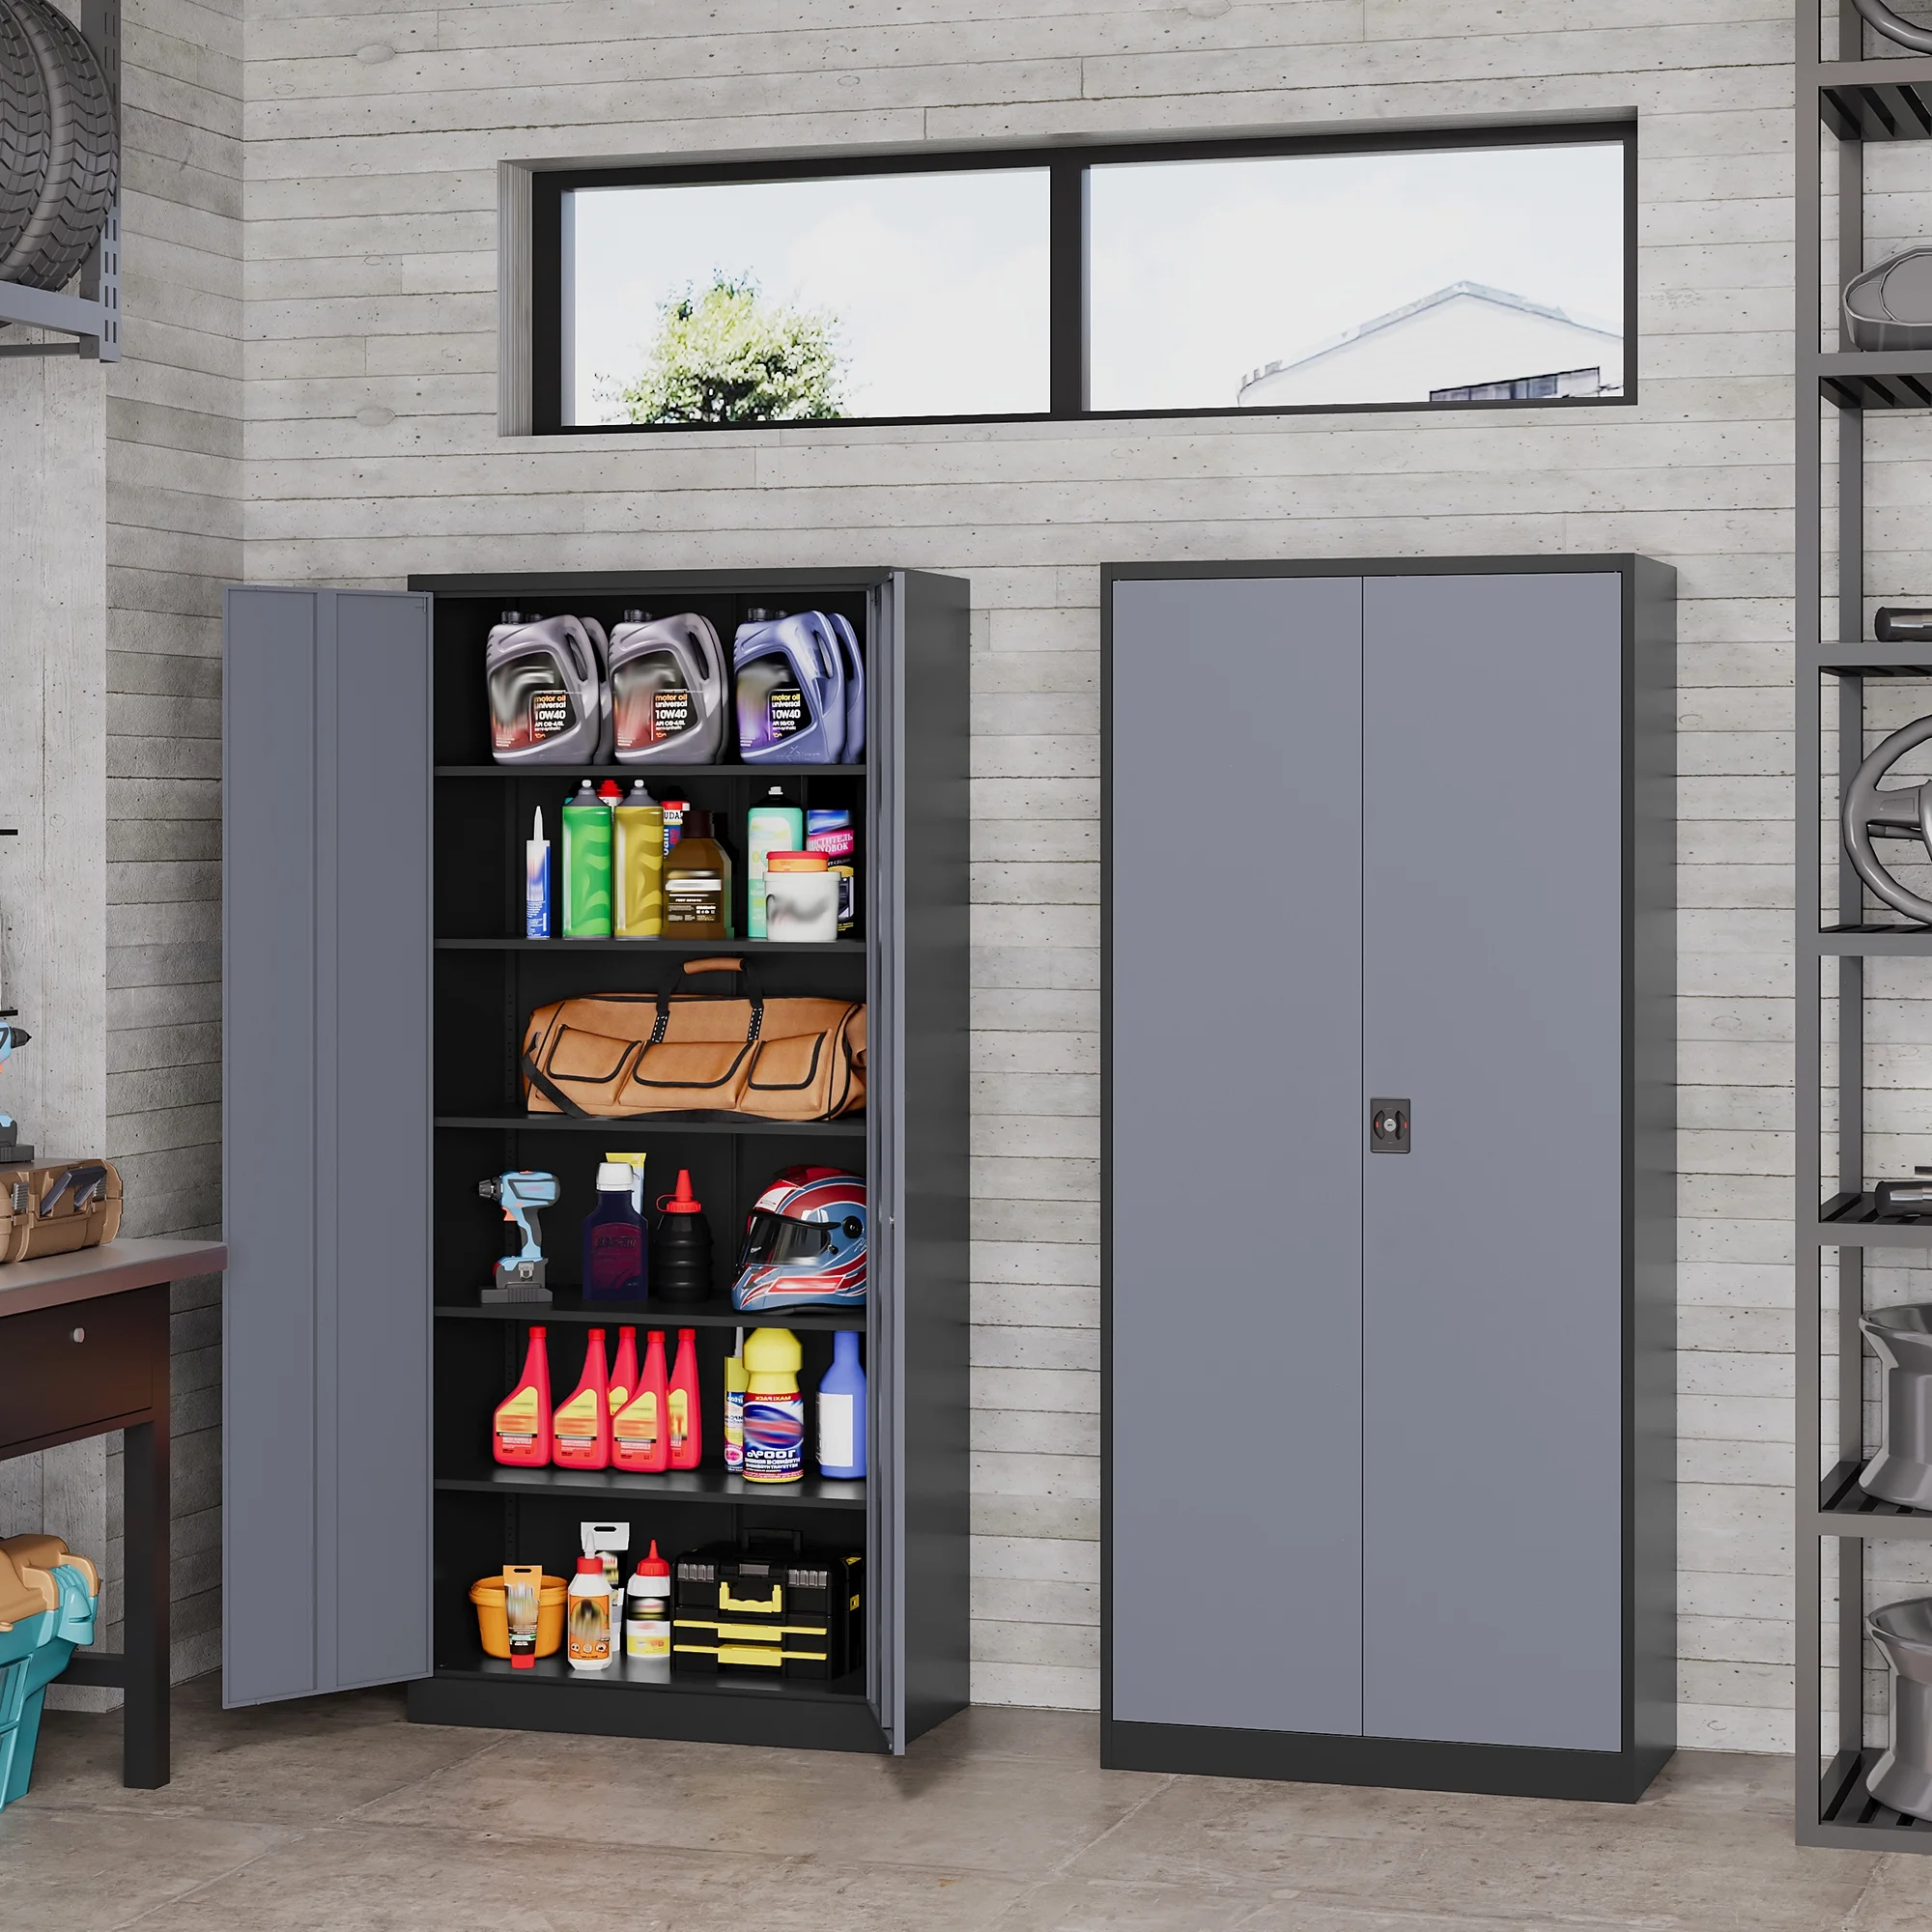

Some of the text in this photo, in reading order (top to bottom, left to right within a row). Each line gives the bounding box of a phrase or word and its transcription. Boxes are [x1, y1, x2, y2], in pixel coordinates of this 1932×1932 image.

[535, 710, 566, 721] 10W40
[655, 709, 688, 720] 10W40
[772, 709, 801, 720] 10W40
